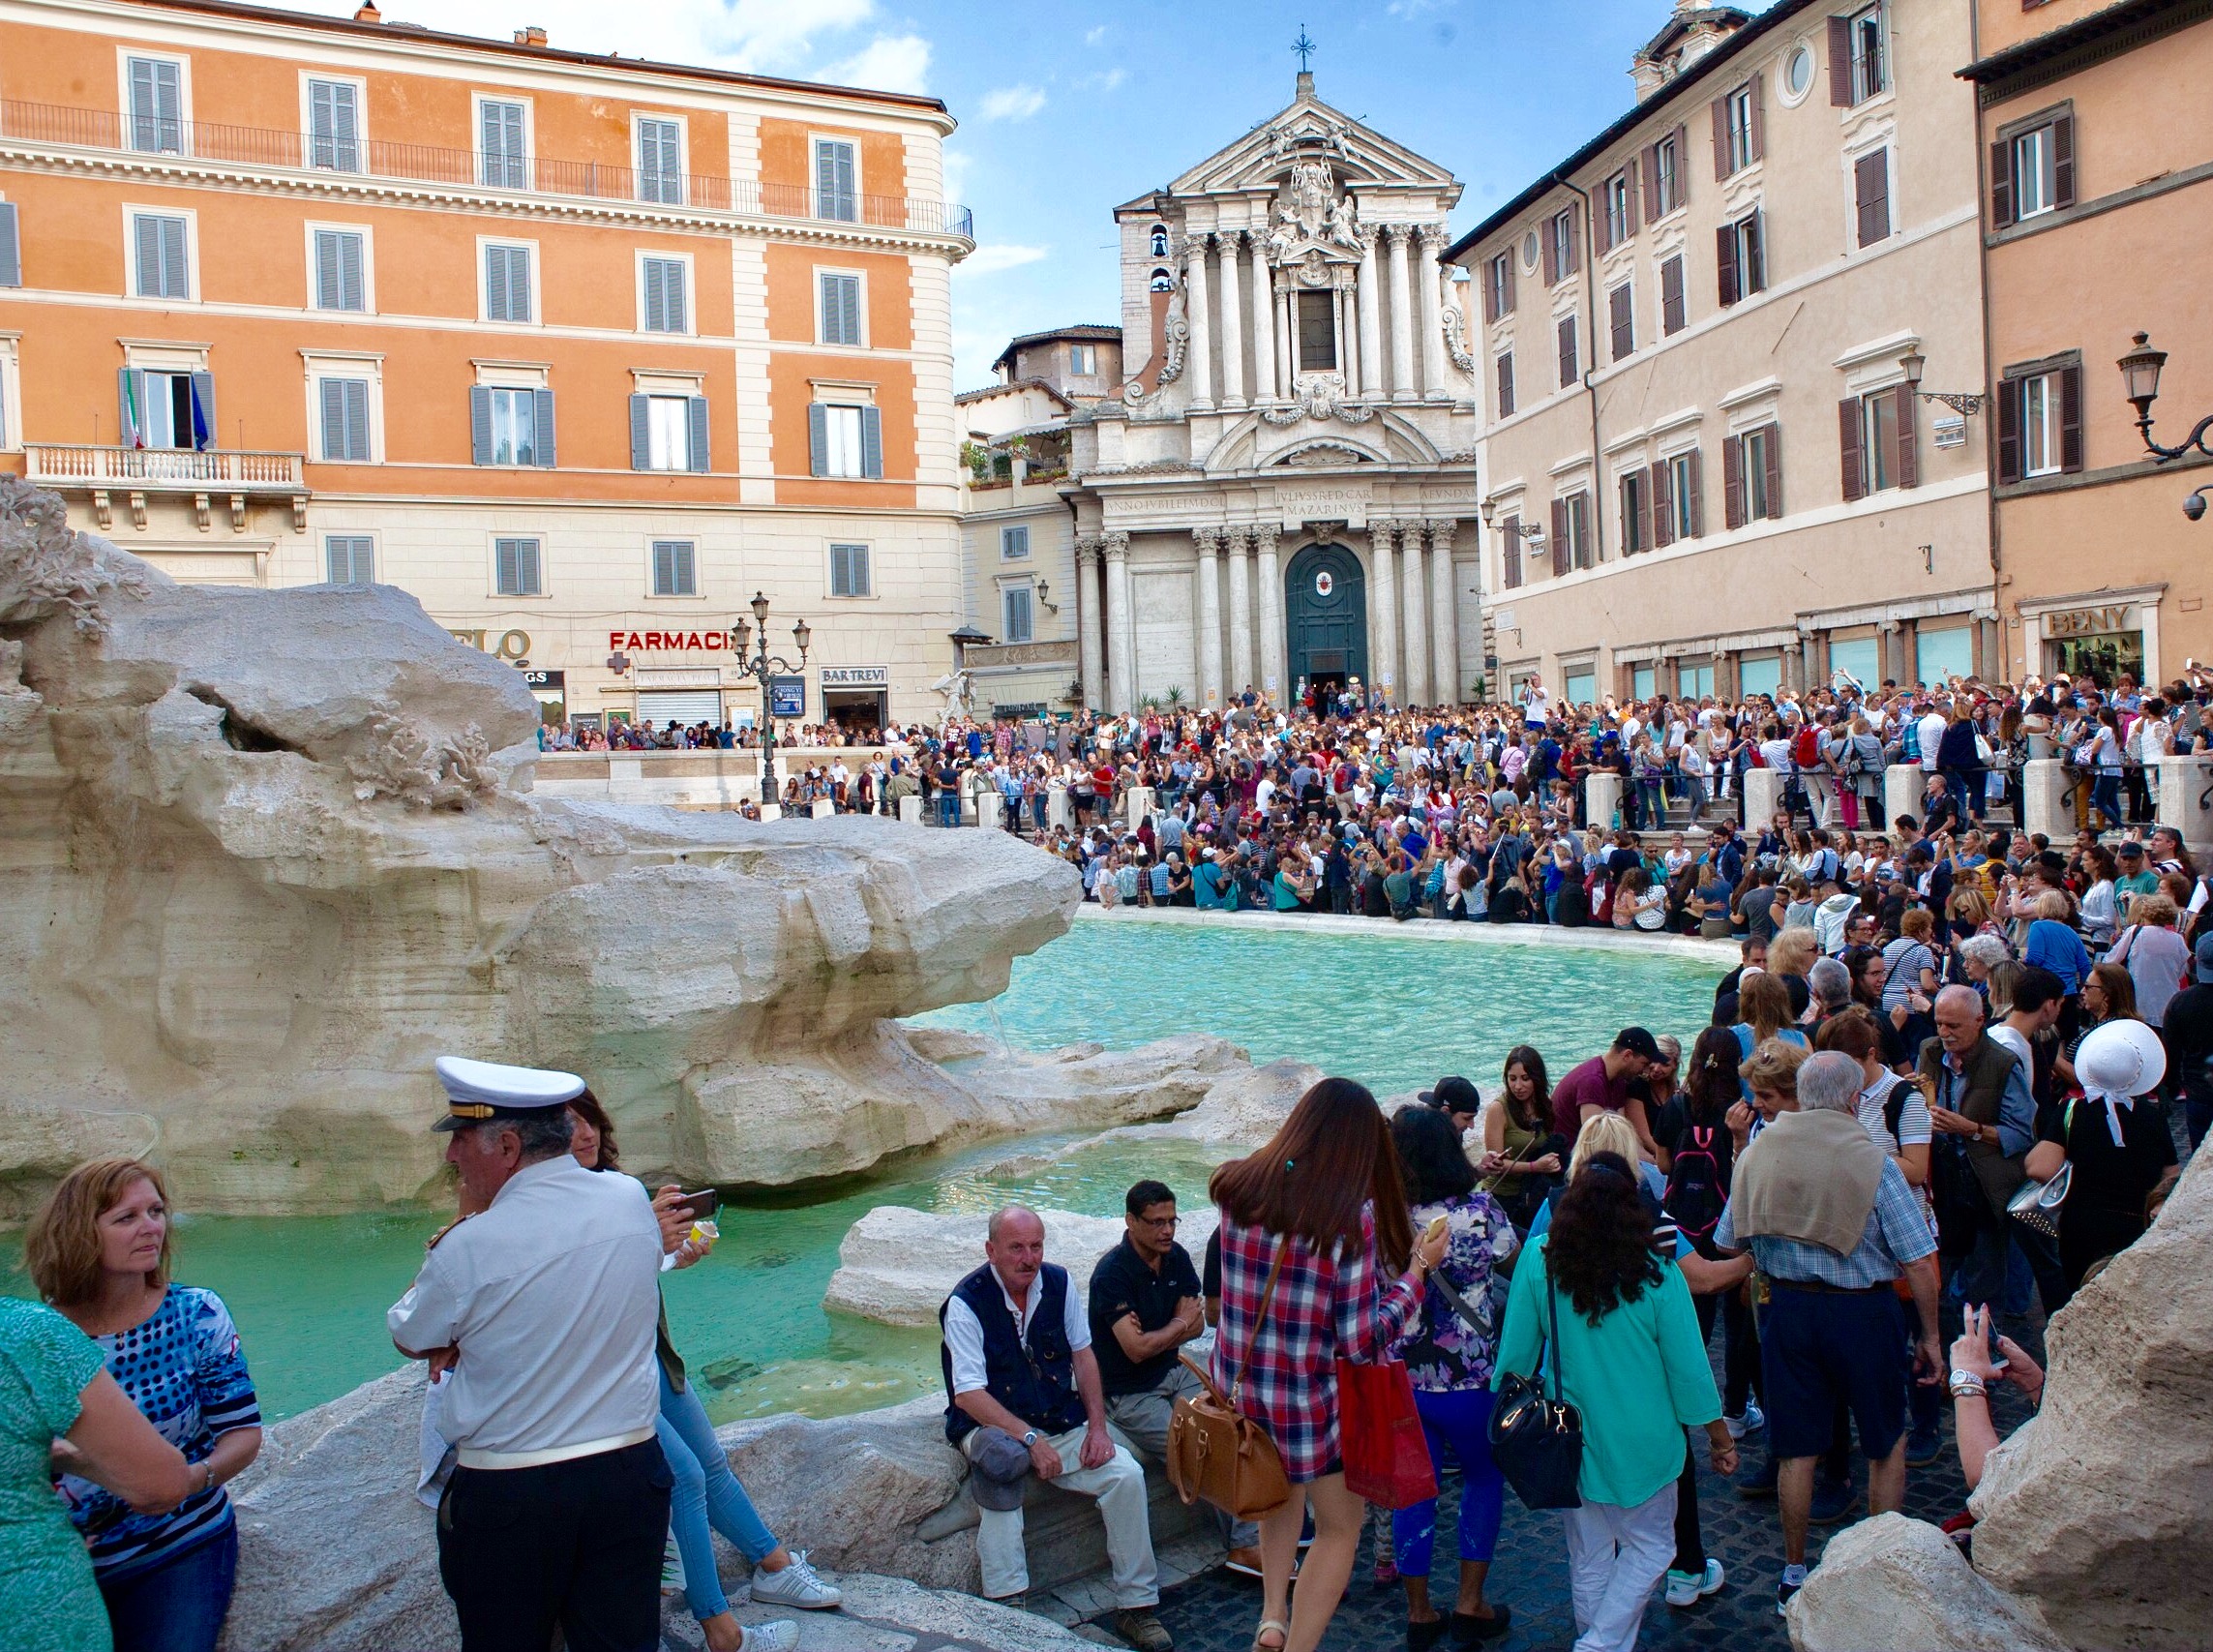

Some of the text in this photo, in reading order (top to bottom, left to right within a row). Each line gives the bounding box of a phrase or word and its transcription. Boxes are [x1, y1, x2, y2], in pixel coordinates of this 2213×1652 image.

[1287, 503, 1363, 516] MAZARINVS
[2048, 606, 2128, 634] BENY
[610, 632, 735, 650] FARMACI
[823, 669, 884, 681] BAR TREVI
[948, 733, 958, 742] 36
